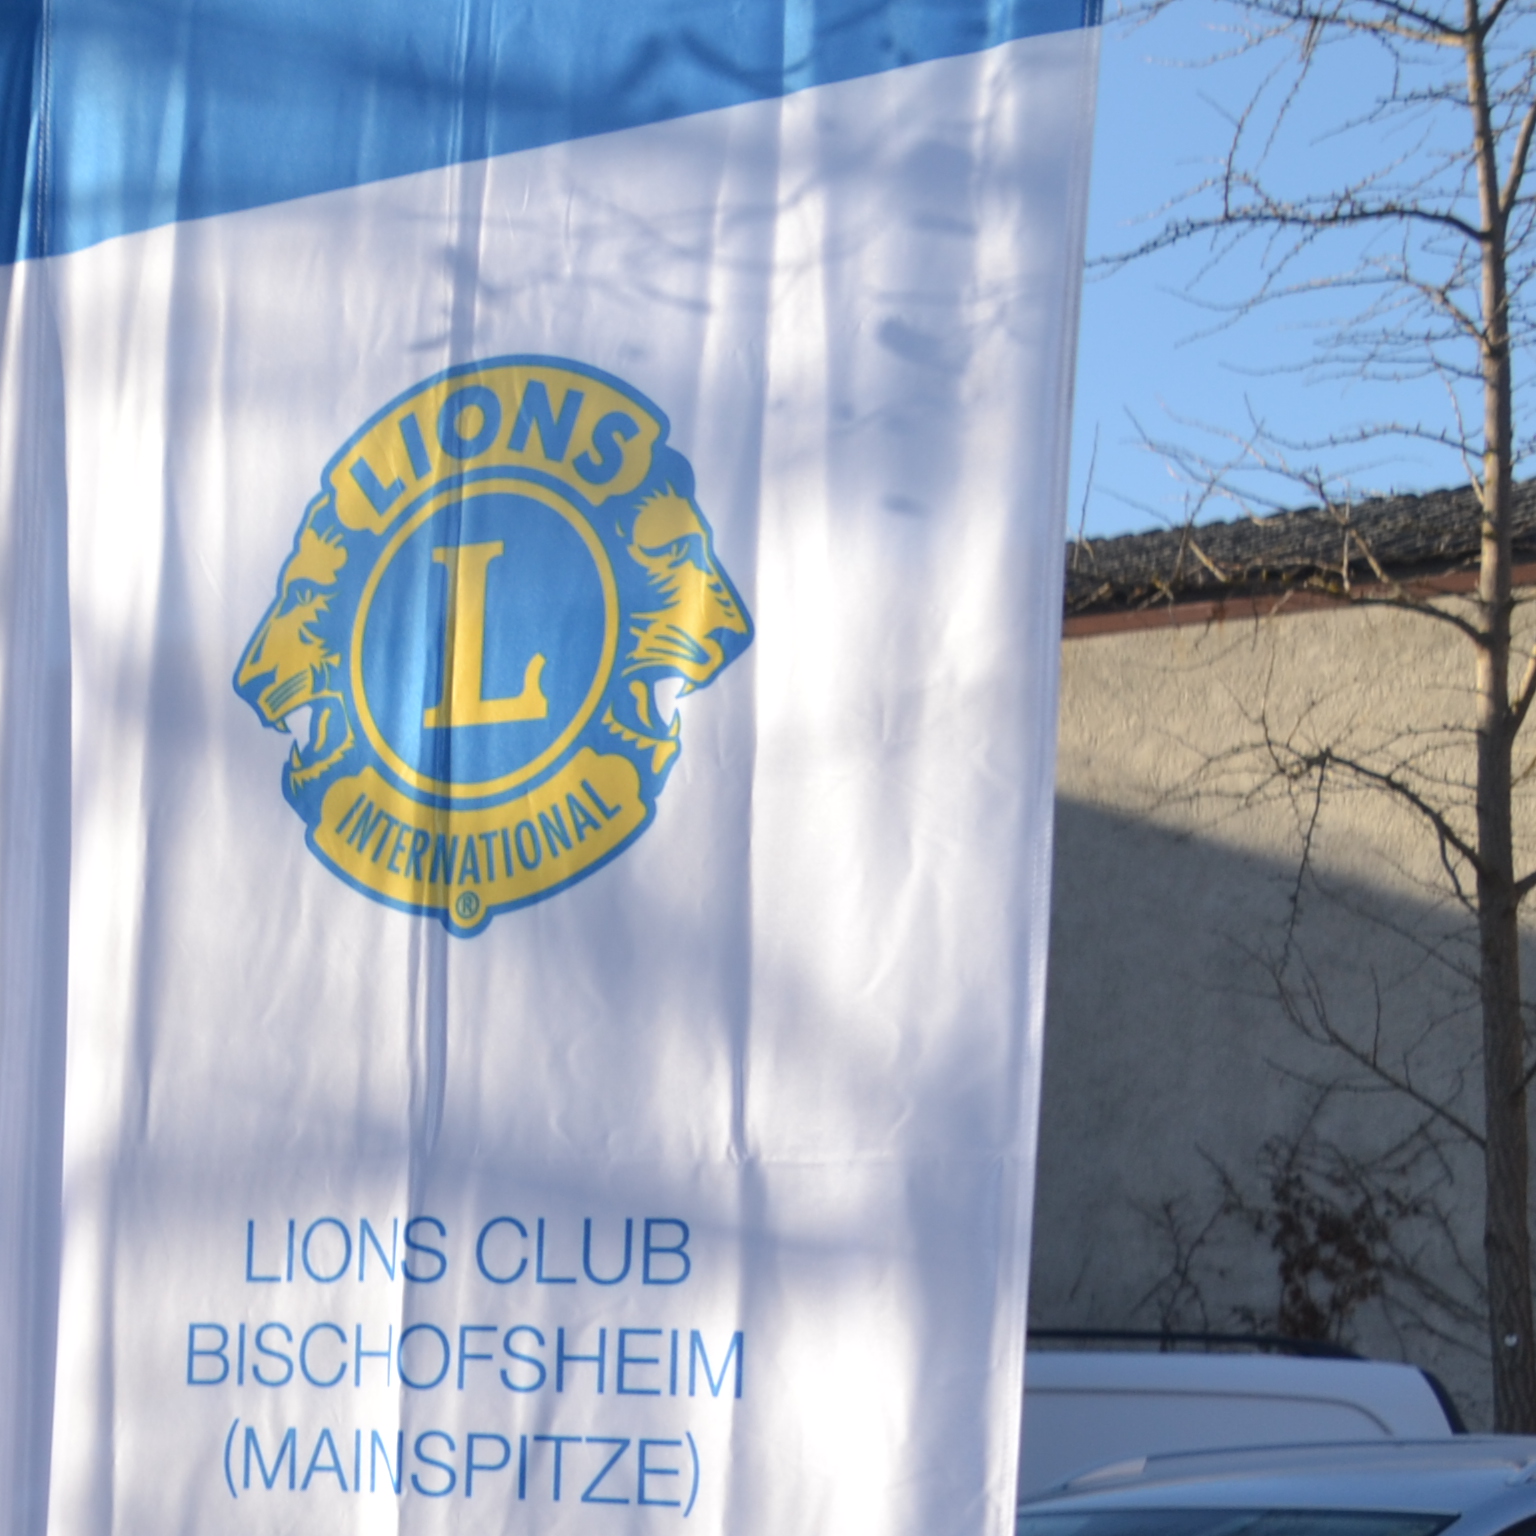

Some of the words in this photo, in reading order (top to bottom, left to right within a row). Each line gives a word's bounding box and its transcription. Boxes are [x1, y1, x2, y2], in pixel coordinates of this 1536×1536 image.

[349, 379, 640, 517] LIONS
[423, 540, 548, 729] L
[335, 778, 621, 886] INTERNATIONAL
[245, 1215, 447, 1285] LIONS
[475, 1215, 692, 1286] CLUB
[186, 1321, 745, 1400] BISCHOFSHEIM
[223, 1417, 700, 1518] (MAINSPITZE)
